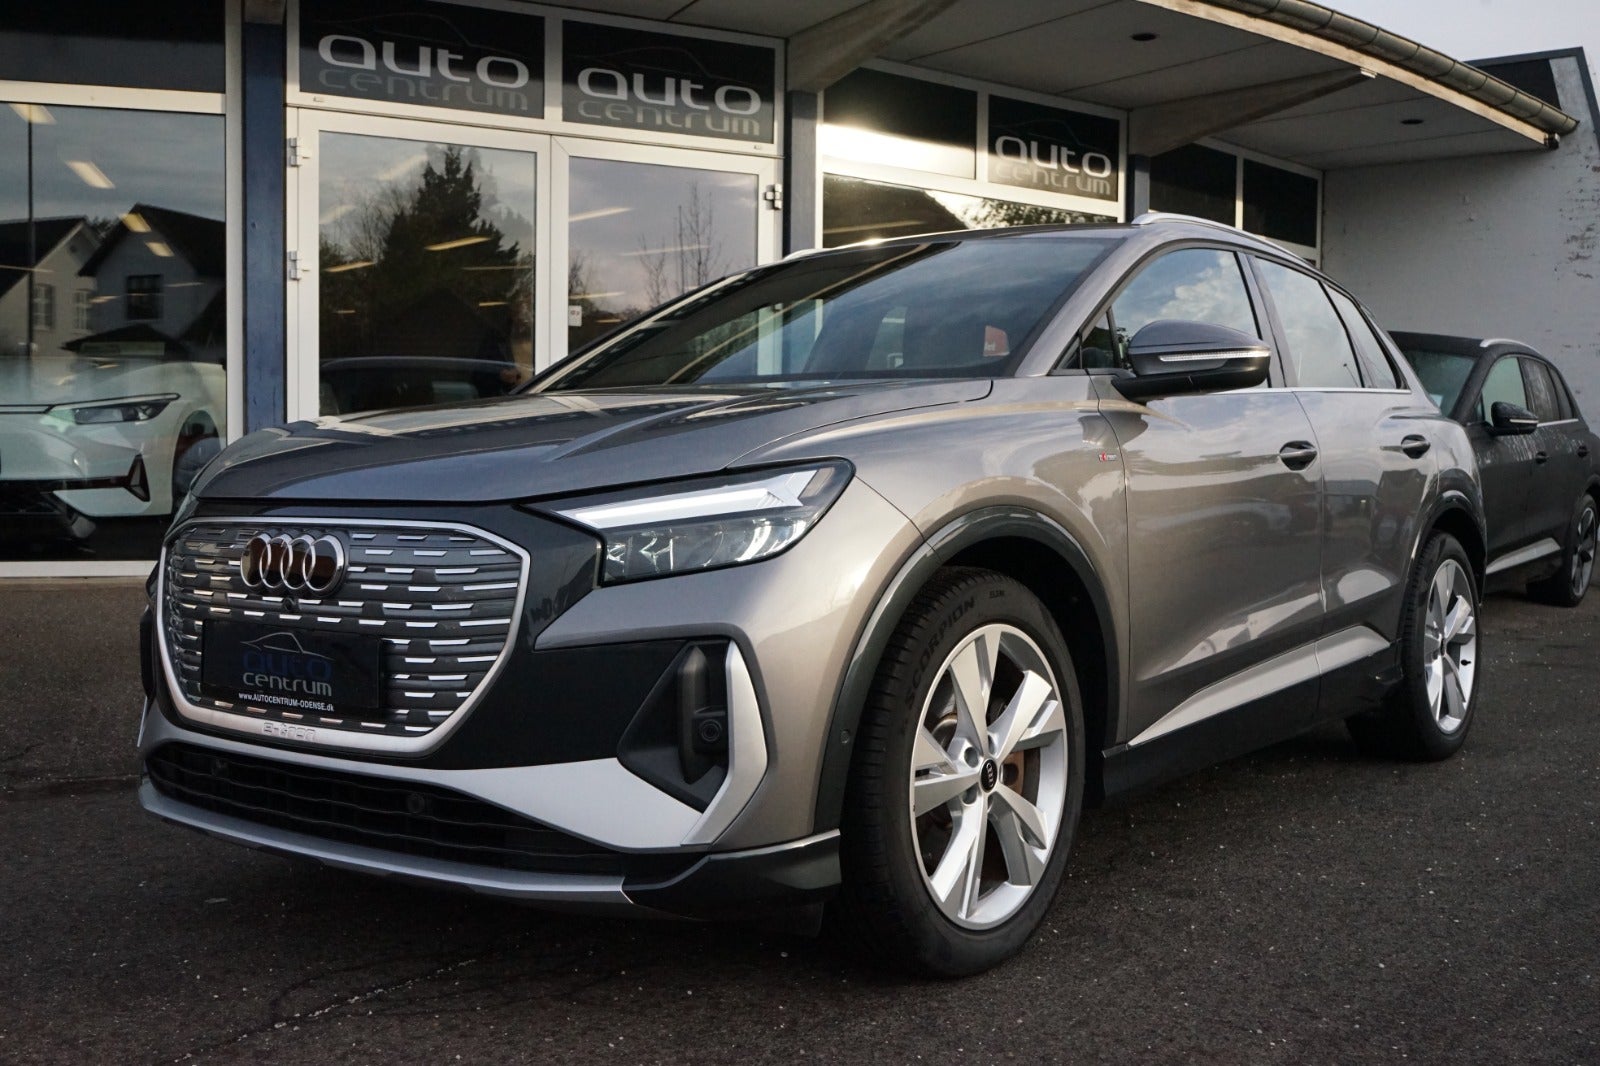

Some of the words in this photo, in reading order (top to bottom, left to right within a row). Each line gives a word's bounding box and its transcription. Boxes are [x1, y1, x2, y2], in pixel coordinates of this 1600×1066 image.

[318, 34, 530, 89] auto
[319, 68, 528, 111] centrum
[577, 67, 762, 115] auto
[578, 99, 760, 136] centrum
[995, 135, 1112, 178] auto
[995, 161, 1111, 196] centrum
[238, 692, 335, 711] www.AUTOCENTRUM-ODENSE.dk
[243, 672, 332, 697] centrum
